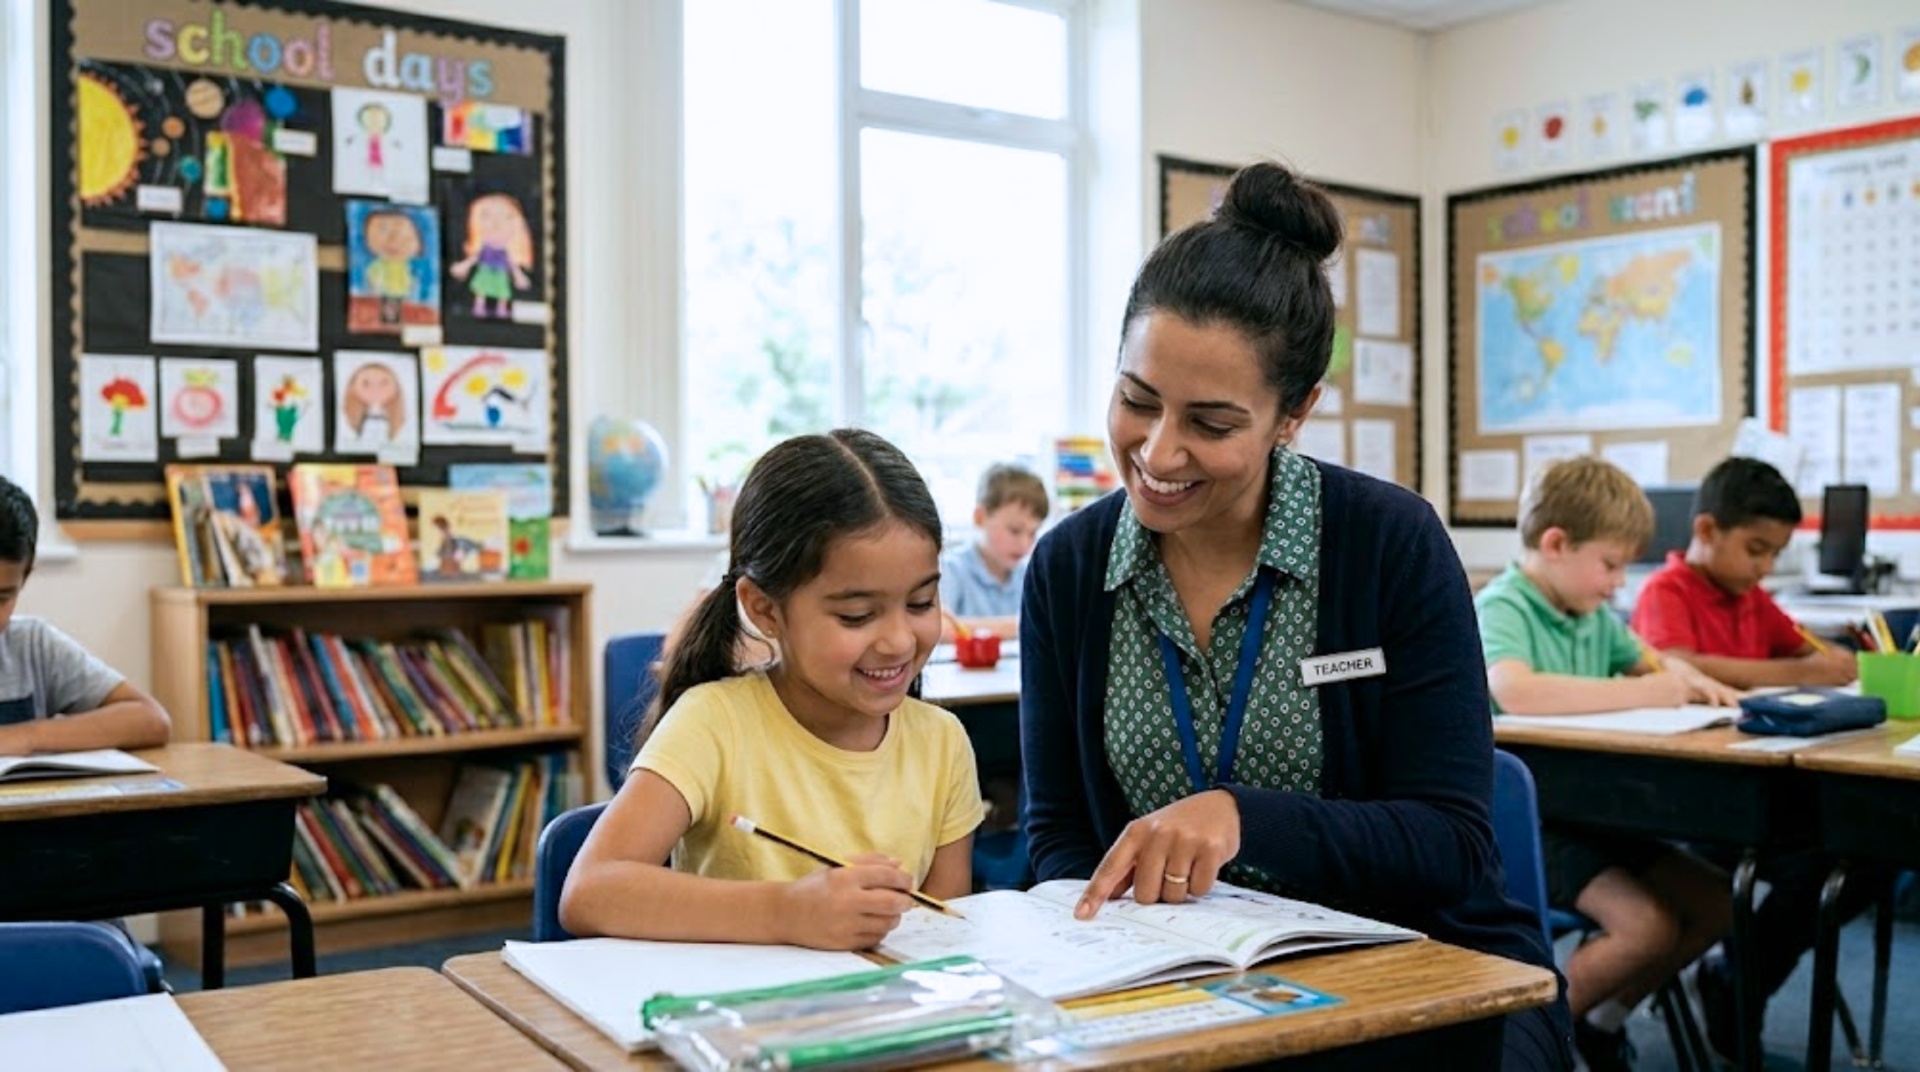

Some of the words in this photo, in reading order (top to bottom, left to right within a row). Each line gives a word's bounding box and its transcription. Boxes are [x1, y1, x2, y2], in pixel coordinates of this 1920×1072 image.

[145, 9, 334, 80] school
[362, 29, 493, 104] days
[1313, 657, 1373, 676] TEACHER
